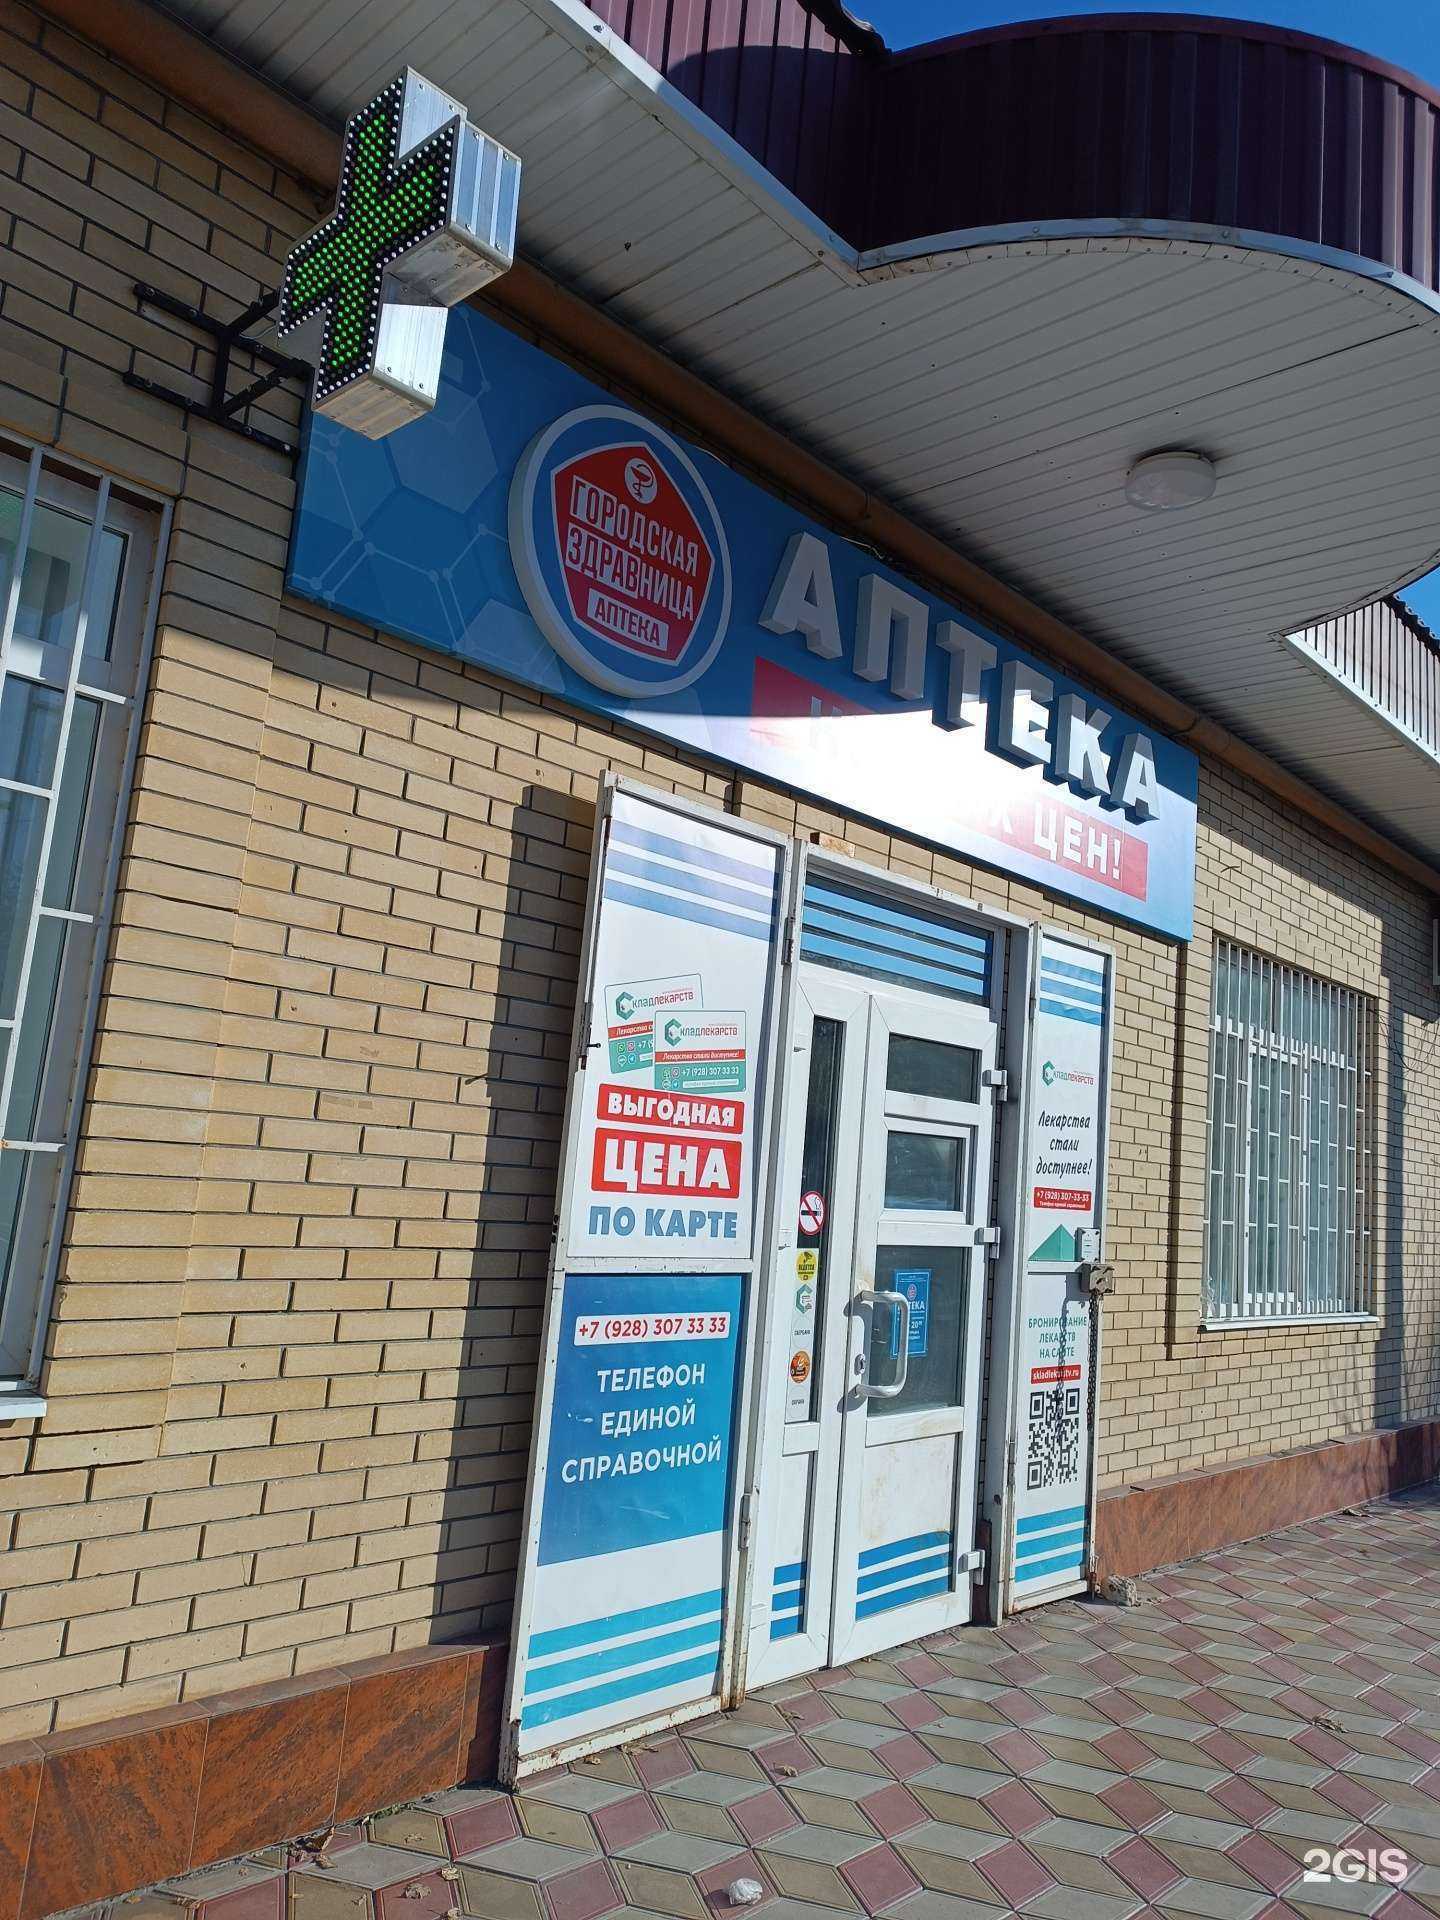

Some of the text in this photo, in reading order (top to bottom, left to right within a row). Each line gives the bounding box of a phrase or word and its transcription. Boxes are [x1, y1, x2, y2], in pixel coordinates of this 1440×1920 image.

[571, 478, 698, 577] ГОРОДСКАЯ
[566, 525, 694, 621] ЗДРАВНИЦА
[593, 597, 661, 646] АПТЕКА
[758, 532, 1160, 822] АПТЕКА
[1033, 800, 1121, 881] ЦЕН!
[681, 1067, 690, 1076] +7
[691, 1067, 707, 1076] (928)
[709, 1067, 720, 1075] 307
[607, 1092, 735, 1127] ВЫГОДНАЯ
[1038, 1111, 1091, 1129] Лекарства
[1049, 1137, 1079, 1151] стали
[603, 1138, 731, 1191] ЦЕНА
[1035, 1156, 1092, 1179] доступнее!
[588, 1205, 738, 1239] ПО КАРТЕ
[579, 1317, 726, 1339] +7 (928) 307 33 33
[1028, 1316, 1087, 1328] БРОНИРОАНИЕ
[1040, 1348, 1050, 1358] НА
[597, 1363, 706, 1393] ТЕЛЕФОН
[600, 1398, 696, 1438] ЕДИНОЙ
[561, 1434, 722, 1484] СПРАВОЧНОЙ
